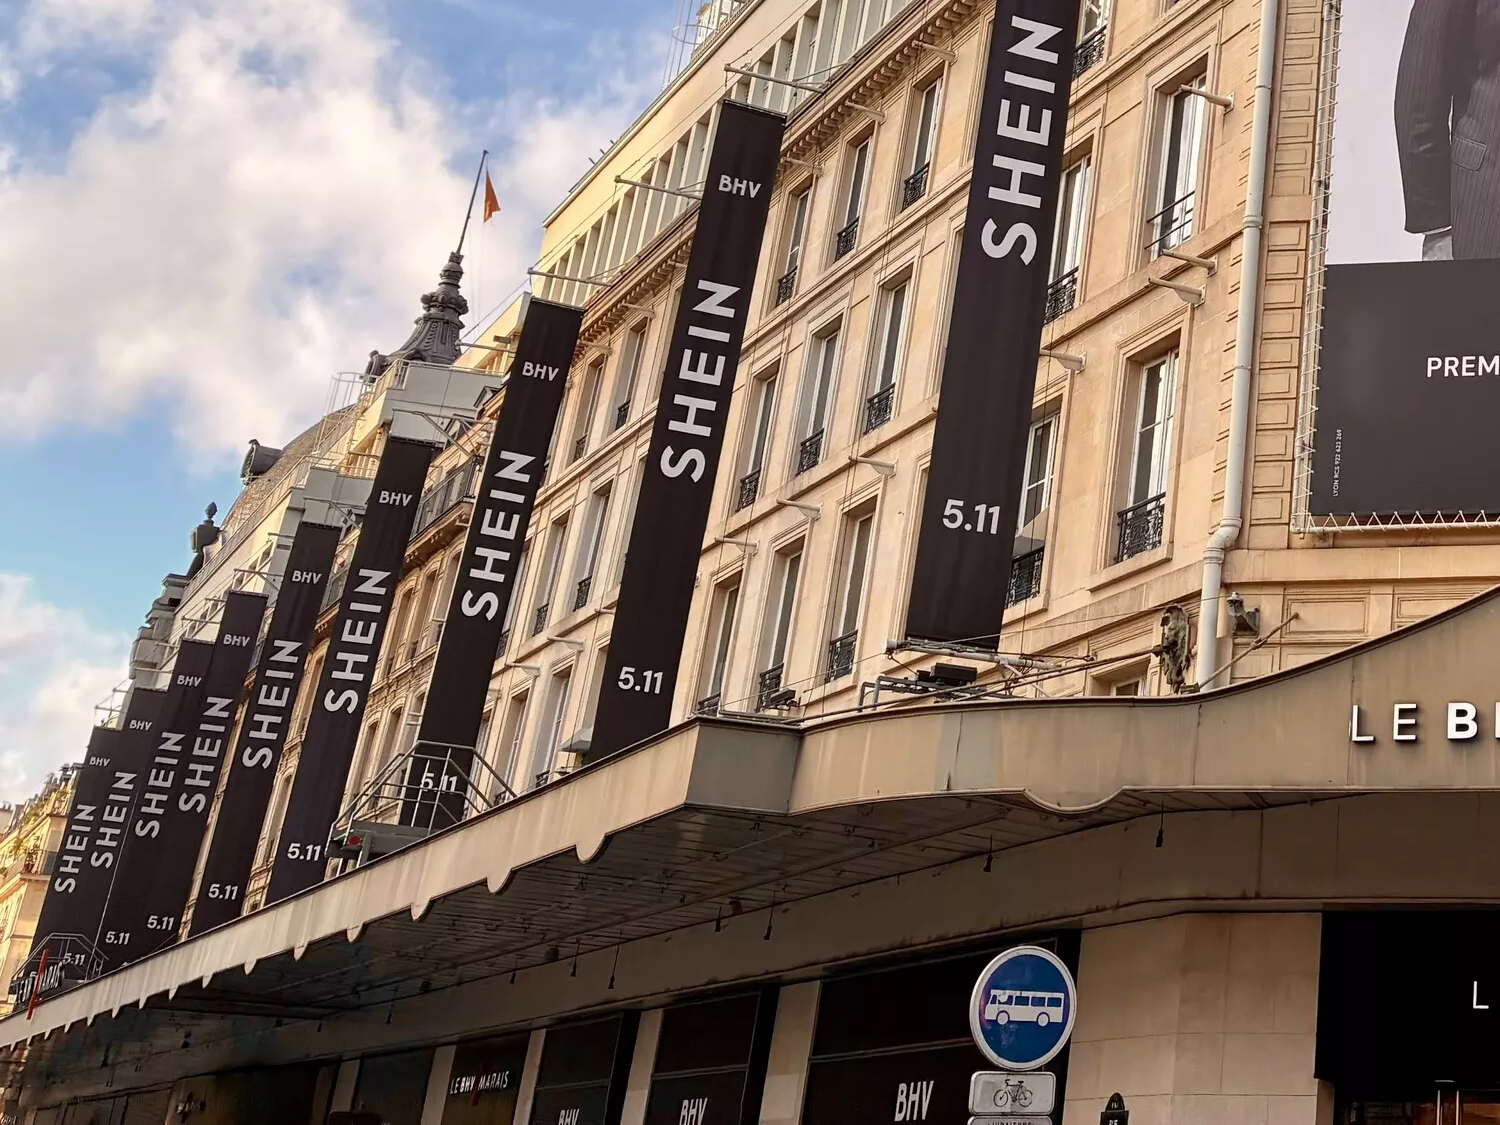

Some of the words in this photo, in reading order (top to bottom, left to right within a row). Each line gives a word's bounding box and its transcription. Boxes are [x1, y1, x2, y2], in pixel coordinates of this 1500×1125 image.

[980, 15, 1066, 267] SHEIN
[718, 174, 762, 199] BHV
[521, 361, 560, 382] BHV
[660, 279, 740, 483] SHEIN
[378, 490, 413, 507] BHV
[942, 498, 1001, 535] 5.11
[461, 449, 537, 622] SHEIN
[291, 570, 322, 585] BHV
[223, 634, 251, 647] BHV
[324, 568, 392, 715] SHEIN
[176, 674, 202, 687] BHV
[617, 666, 663, 694] 5.11
[242, 639, 302, 770] SHEIN
[129, 719, 153, 731] BHV
[1350, 703, 1418, 743] LE
[89, 756, 111, 767] BHV
[179, 696, 234, 814] SHEIN
[135, 731, 186, 839] SHEIN
[421, 772, 458, 794] 5.11
[90, 771, 138, 870] SHEIN
[55, 803, 97, 894] SHEIN
[287, 842, 322, 862] 5.11
[208, 883, 239, 900] 5.11
[146, 915, 175, 931] 5.11
[105, 930, 130, 945] 5.11
[679, 1097, 709, 1125] BHV
[894, 1080, 935, 1122] BHV
[558, 1108, 580, 1125] BHV
